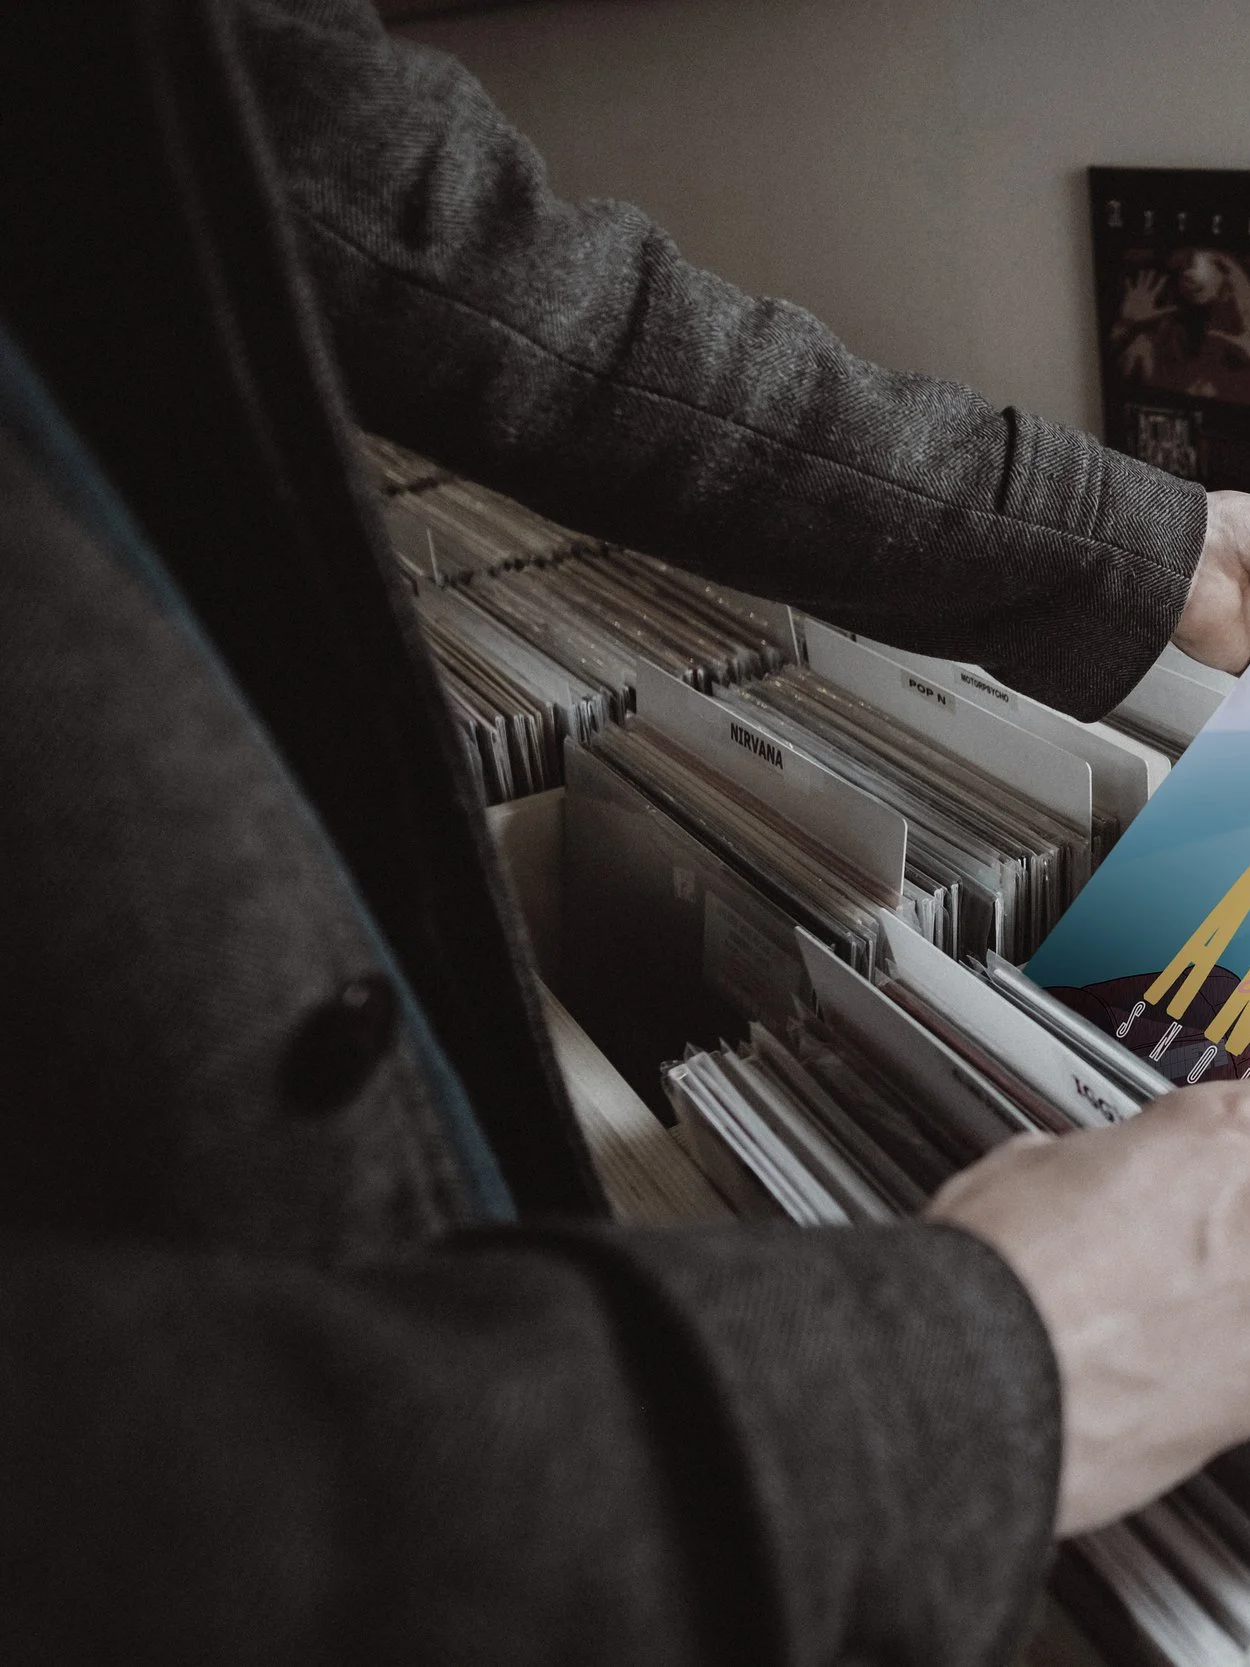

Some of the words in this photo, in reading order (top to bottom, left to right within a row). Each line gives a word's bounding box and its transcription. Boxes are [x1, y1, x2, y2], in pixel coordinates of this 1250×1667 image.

[908, 679, 934, 696] POP
[937, 694, 947, 705] N
[960, 673, 1009, 703] MOTORPSYCHO
[730, 722, 783, 770] NIRVANA
